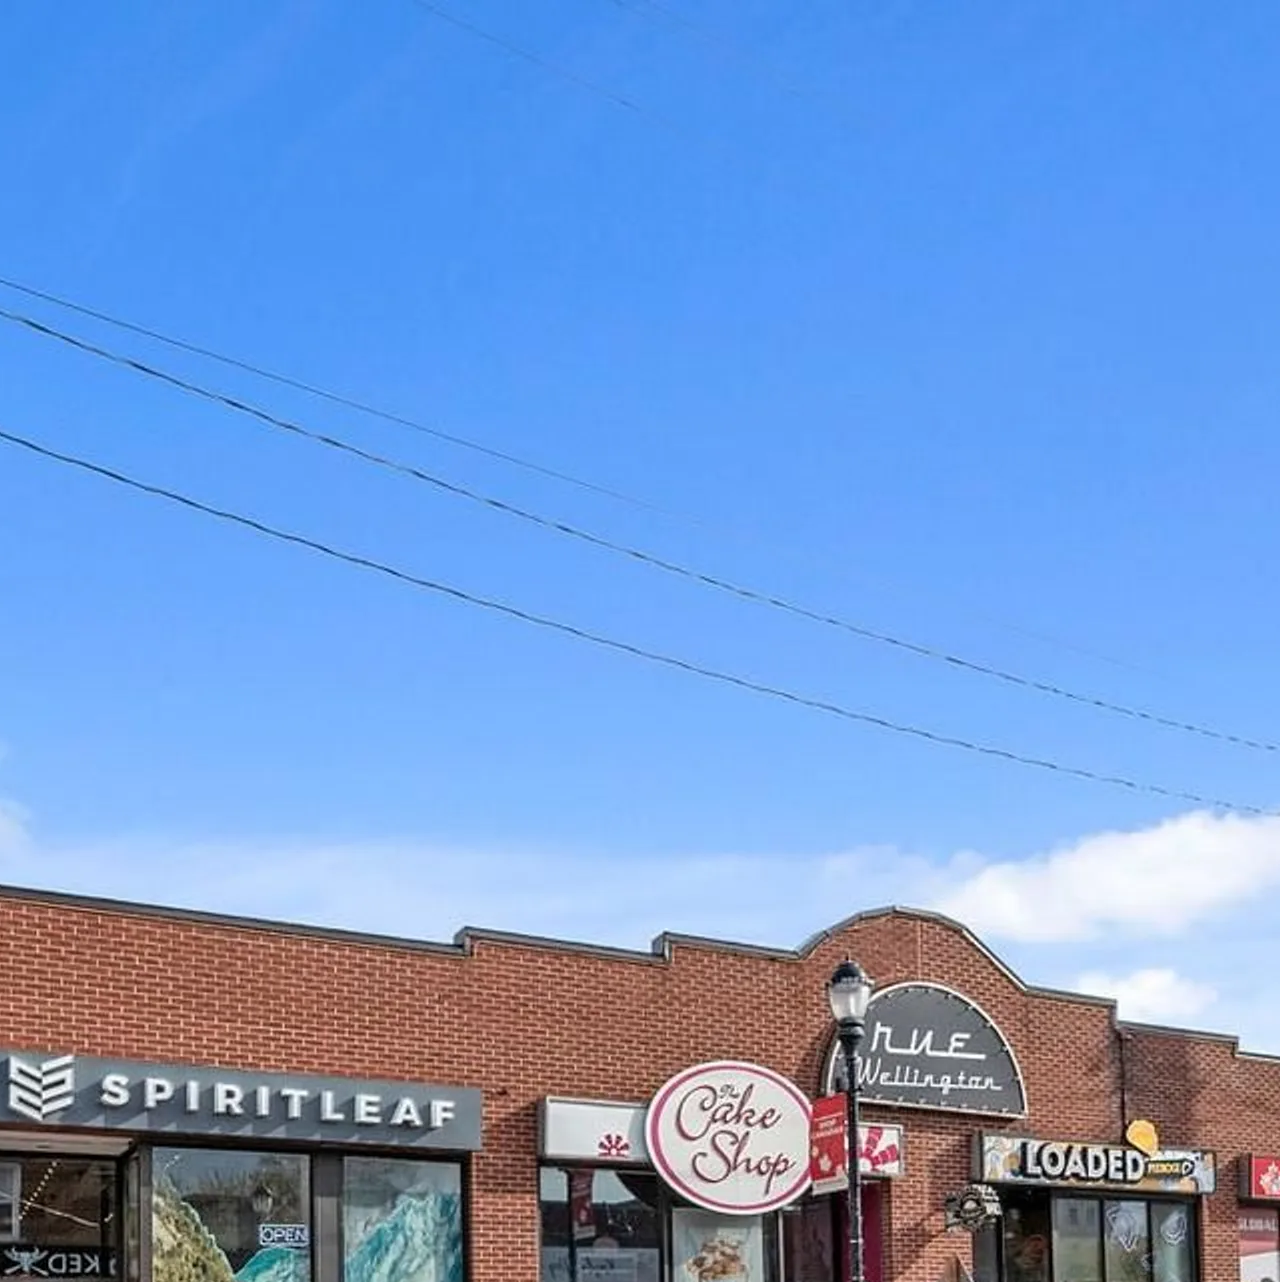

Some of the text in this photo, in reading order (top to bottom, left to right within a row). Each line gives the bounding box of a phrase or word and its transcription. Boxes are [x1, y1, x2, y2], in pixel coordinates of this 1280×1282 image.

[99, 1072, 456, 1128] SPIRITLEAF
[856, 1056, 1003, 1096] Wellington
[675, 1082, 782, 1142] Cake
[691, 1129, 797, 1198] Shop
[1024, 1143, 1146, 1182] LOADED
[261, 1227, 308, 1242] OPEN
